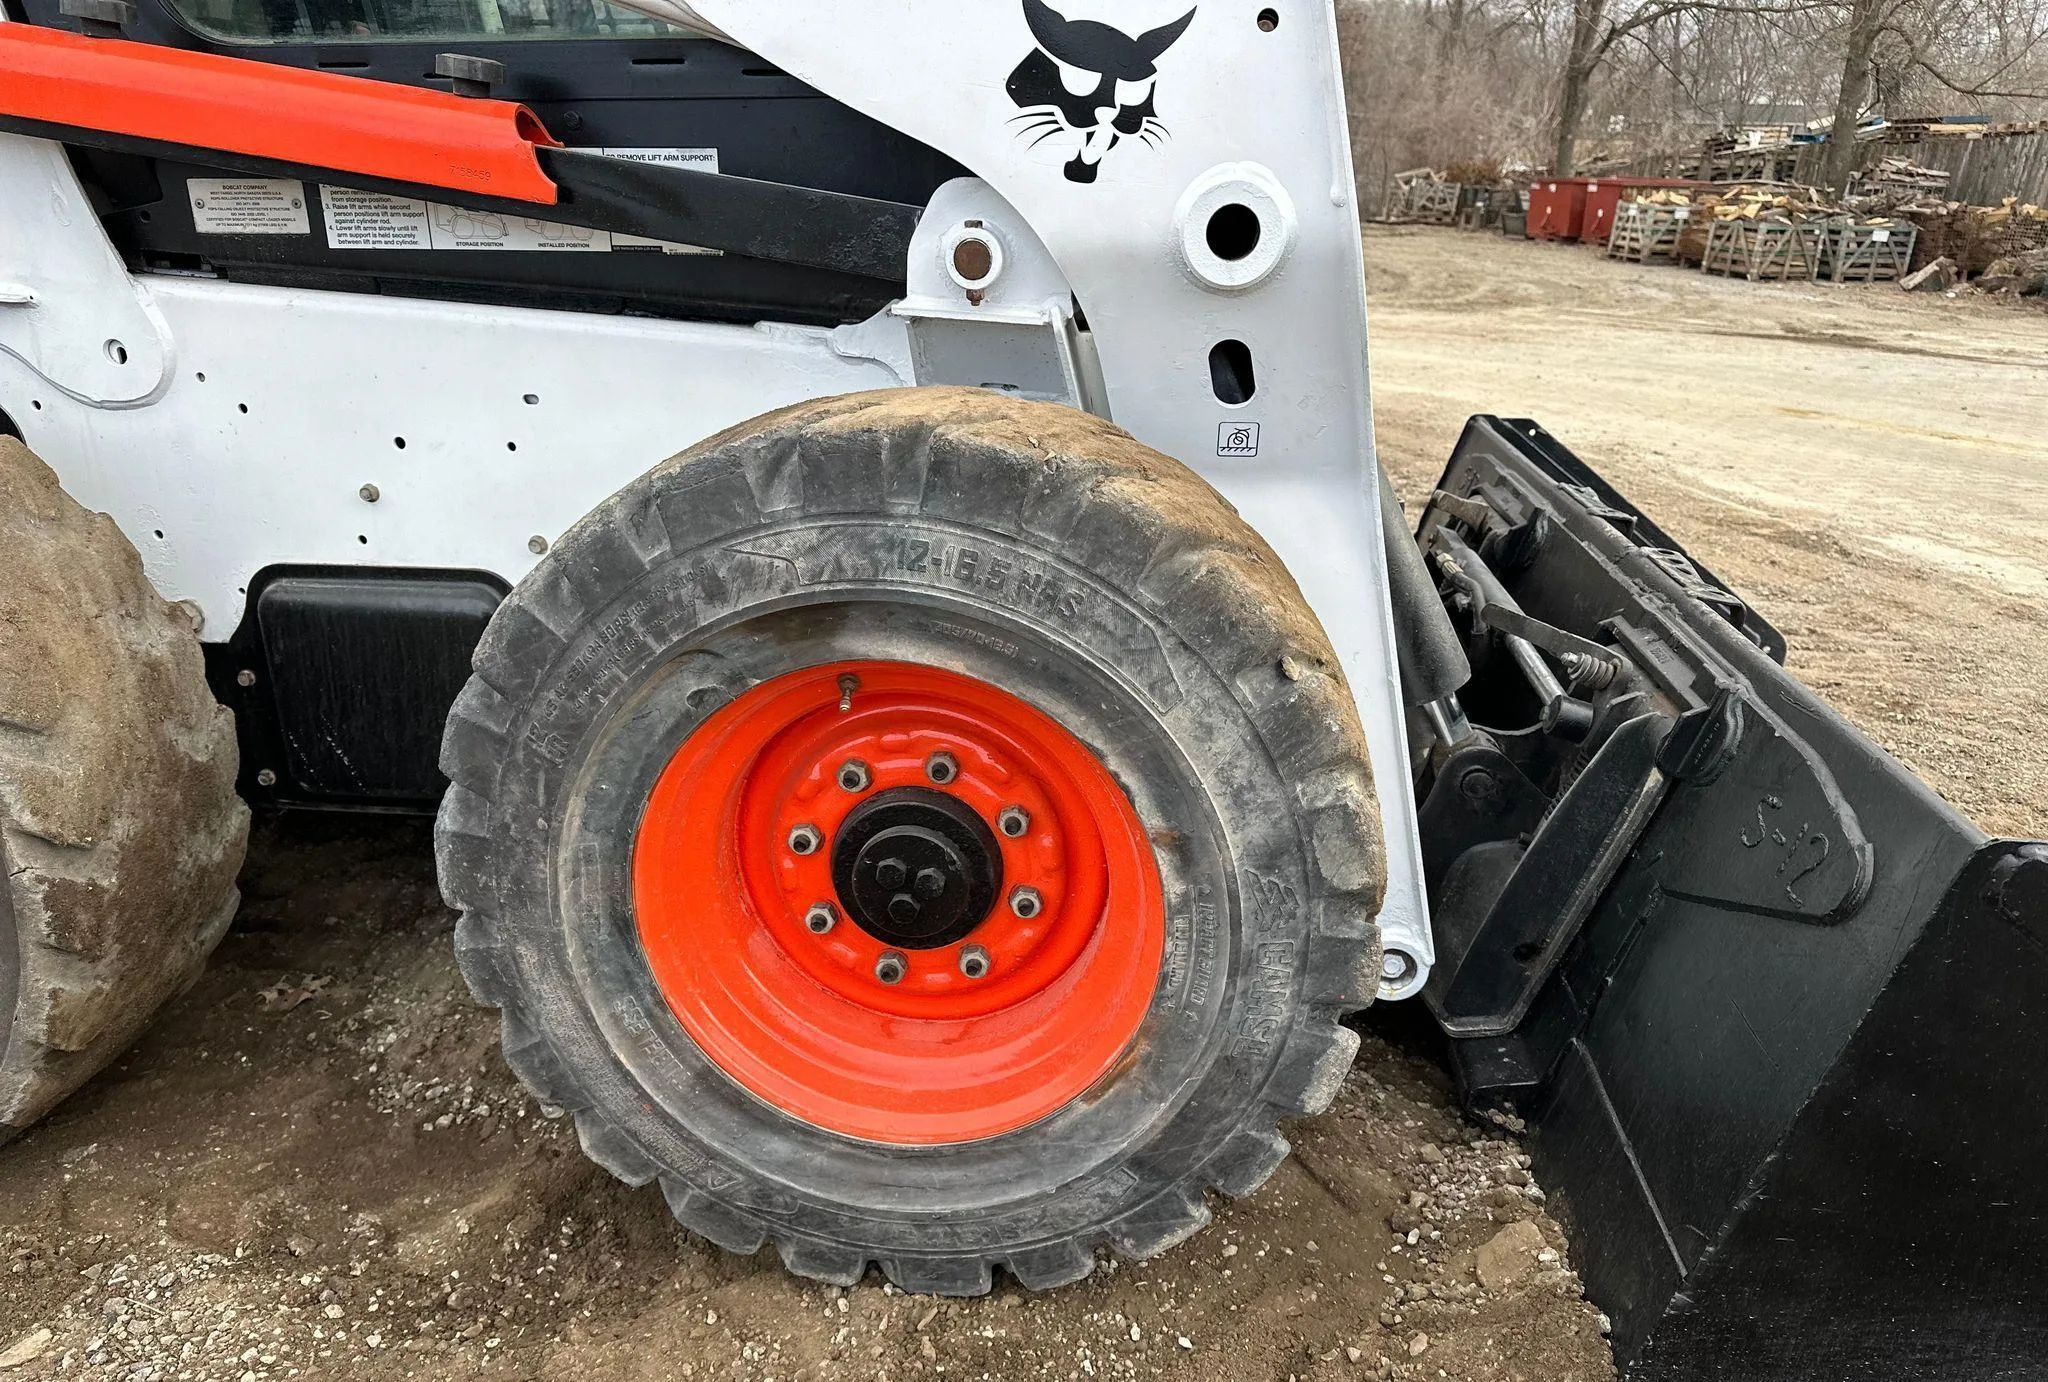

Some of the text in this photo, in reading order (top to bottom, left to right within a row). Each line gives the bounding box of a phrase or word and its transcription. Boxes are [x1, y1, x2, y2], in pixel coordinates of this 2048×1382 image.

[680, 154, 716, 162] SUPPORT:
[345, 196, 368, 204] storage
[368, 196, 393, 204] position.
[402, 211, 425, 219] support
[391, 232, 416, 240] securely
[897, 536, 1013, 591] 12-16.5
